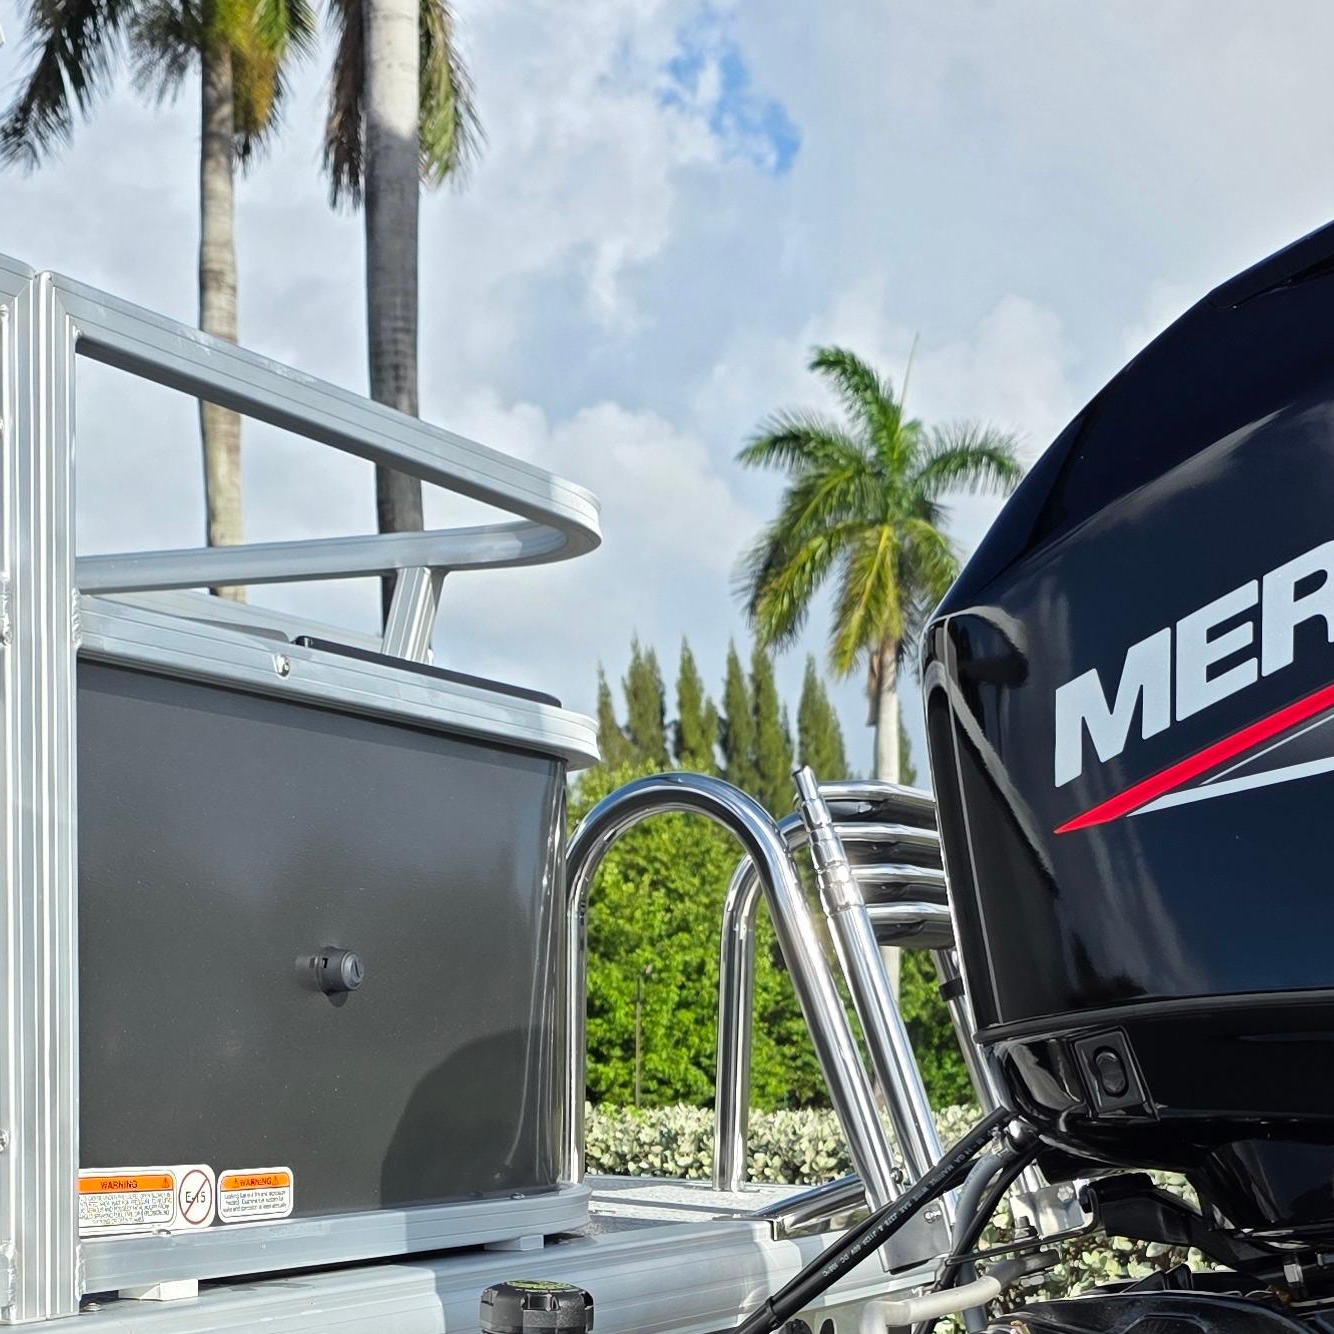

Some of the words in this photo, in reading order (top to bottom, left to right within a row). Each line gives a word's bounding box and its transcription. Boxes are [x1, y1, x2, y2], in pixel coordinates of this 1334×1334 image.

[100, 1180, 138, 1190] WARNING
[240, 1177, 272, 1187] WARNING
[838, 1252, 850, 1264] DC
